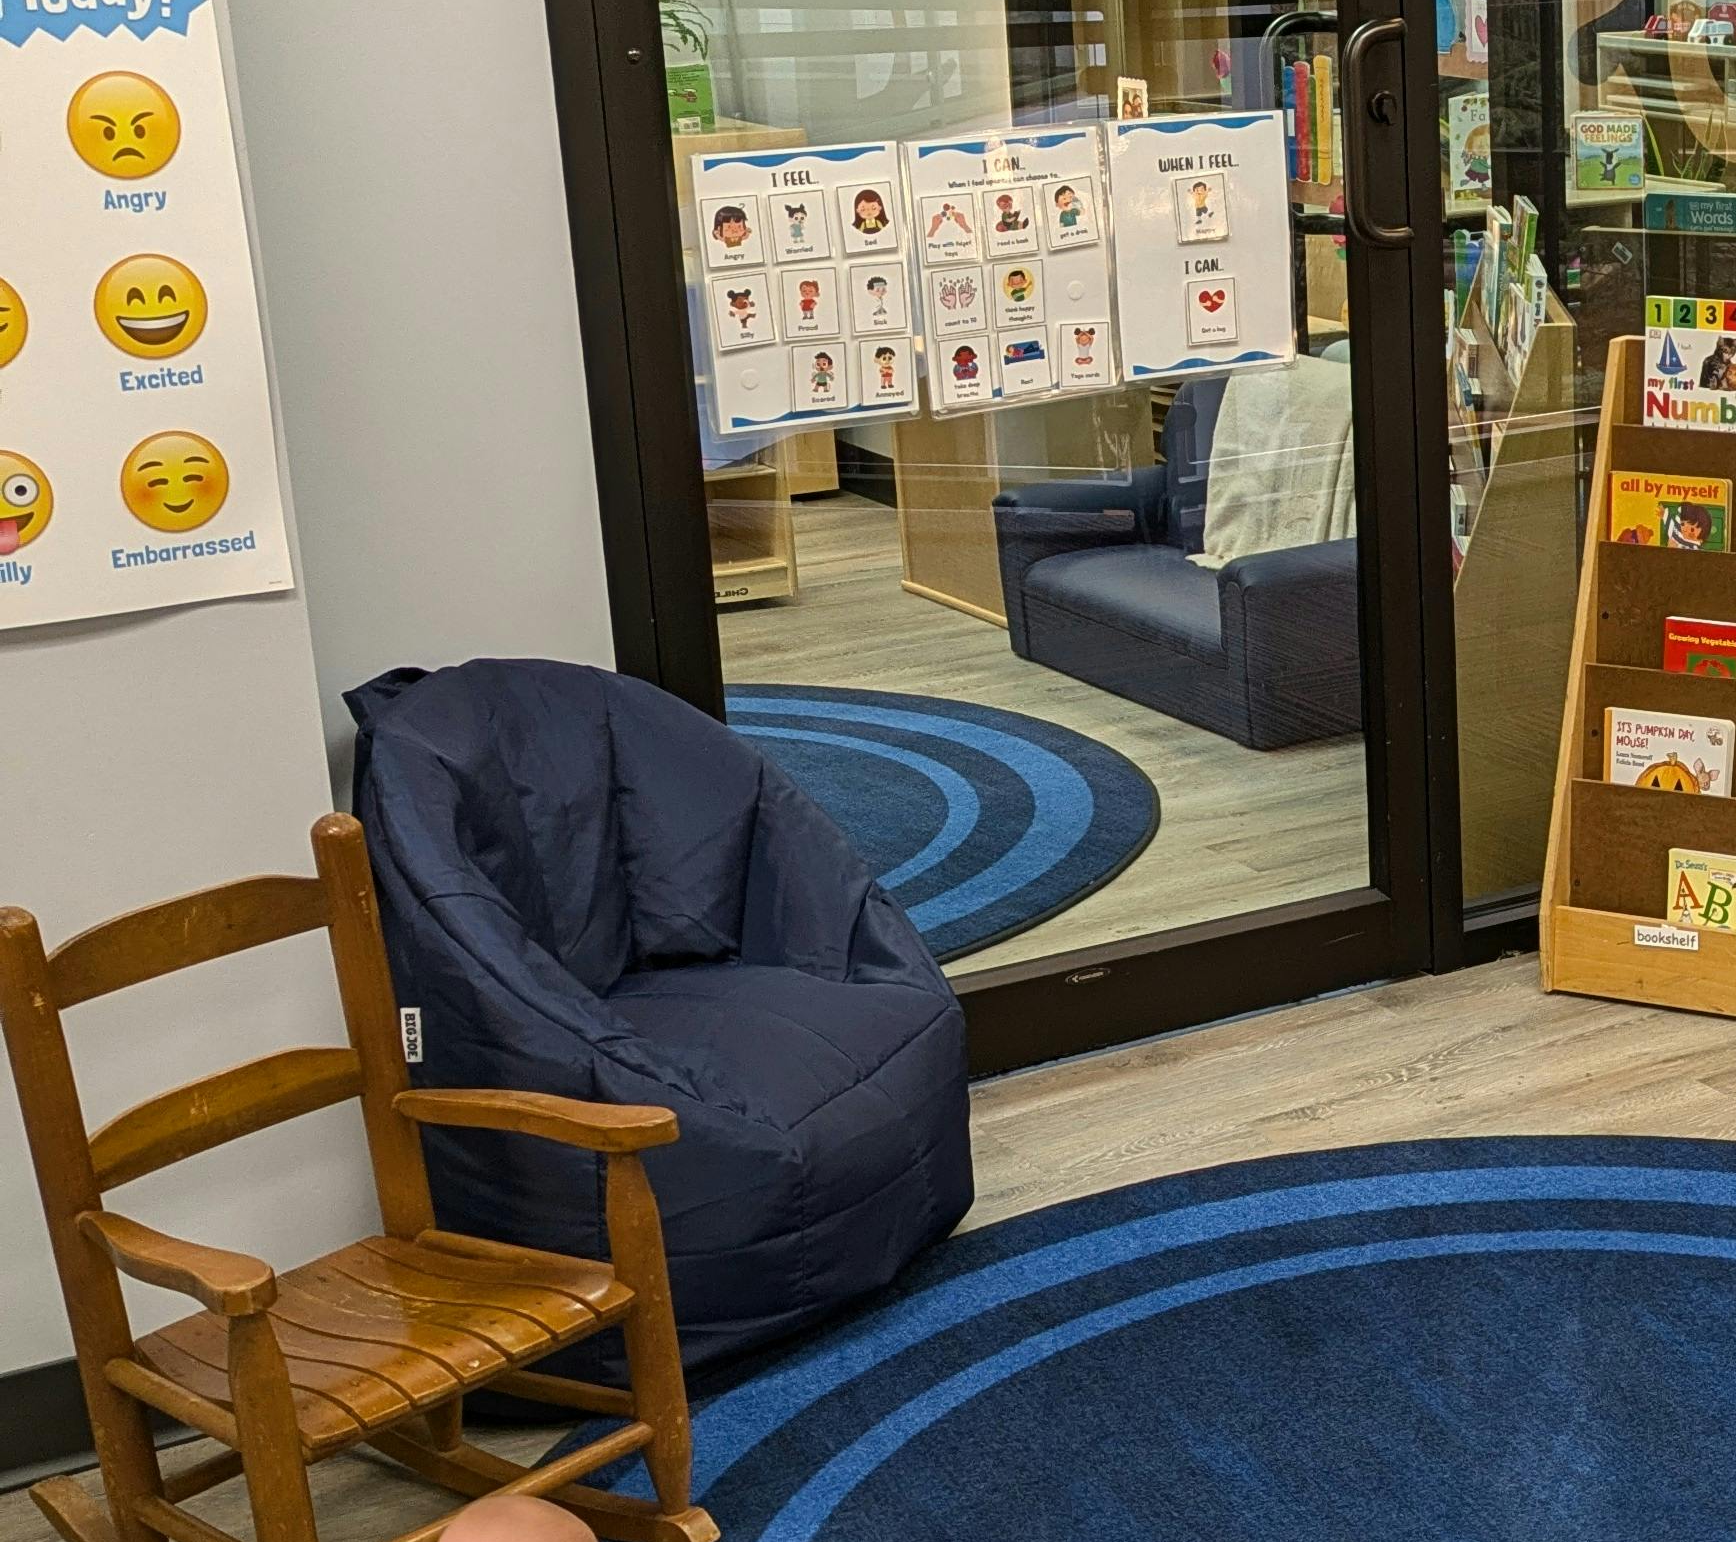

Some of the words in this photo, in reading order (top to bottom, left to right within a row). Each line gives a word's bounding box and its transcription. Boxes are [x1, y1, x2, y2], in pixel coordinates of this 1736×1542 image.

[1580, 124, 1604, 135] GOD
[1606, 123, 1638, 135] MADE
[1584, 133, 1633, 144] FEELINGS
[982, 159, 988, 174] I
[1158, 156, 1195, 172] WHEN
[1199, 155, 1204, 169] I
[771, 172, 779, 188] I
[104, 189, 167, 214] Angry
[1691, 211, 1734, 225] Words
[1184, 261, 1190, 275] I
[1653, 303, 1662, 323] 1
[1678, 304, 1692, 324] 2
[1705, 305, 1718, 325] 3
[119, 366, 204, 392] Excited
[1647, 378, 1665, 392] my
[1668, 376, 1696, 391] first
[1620, 479, 1640, 493] all
[1644, 480, 1665, 498] by
[1667, 483, 1720, 500] myself
[111, 531, 256, 569] Embarrassed
[0, 561, 32, 586] illy
[1668, 632, 1700, 646] Growing
[1616, 721, 1632, 734] IT'S
[1635, 724, 1675, 739] PUMPKIN
[1616, 735, 1649, 749] MOUSE!
[1636, 927, 1697, 949] bookshelf
[406, 1036, 419, 1060] JOE
